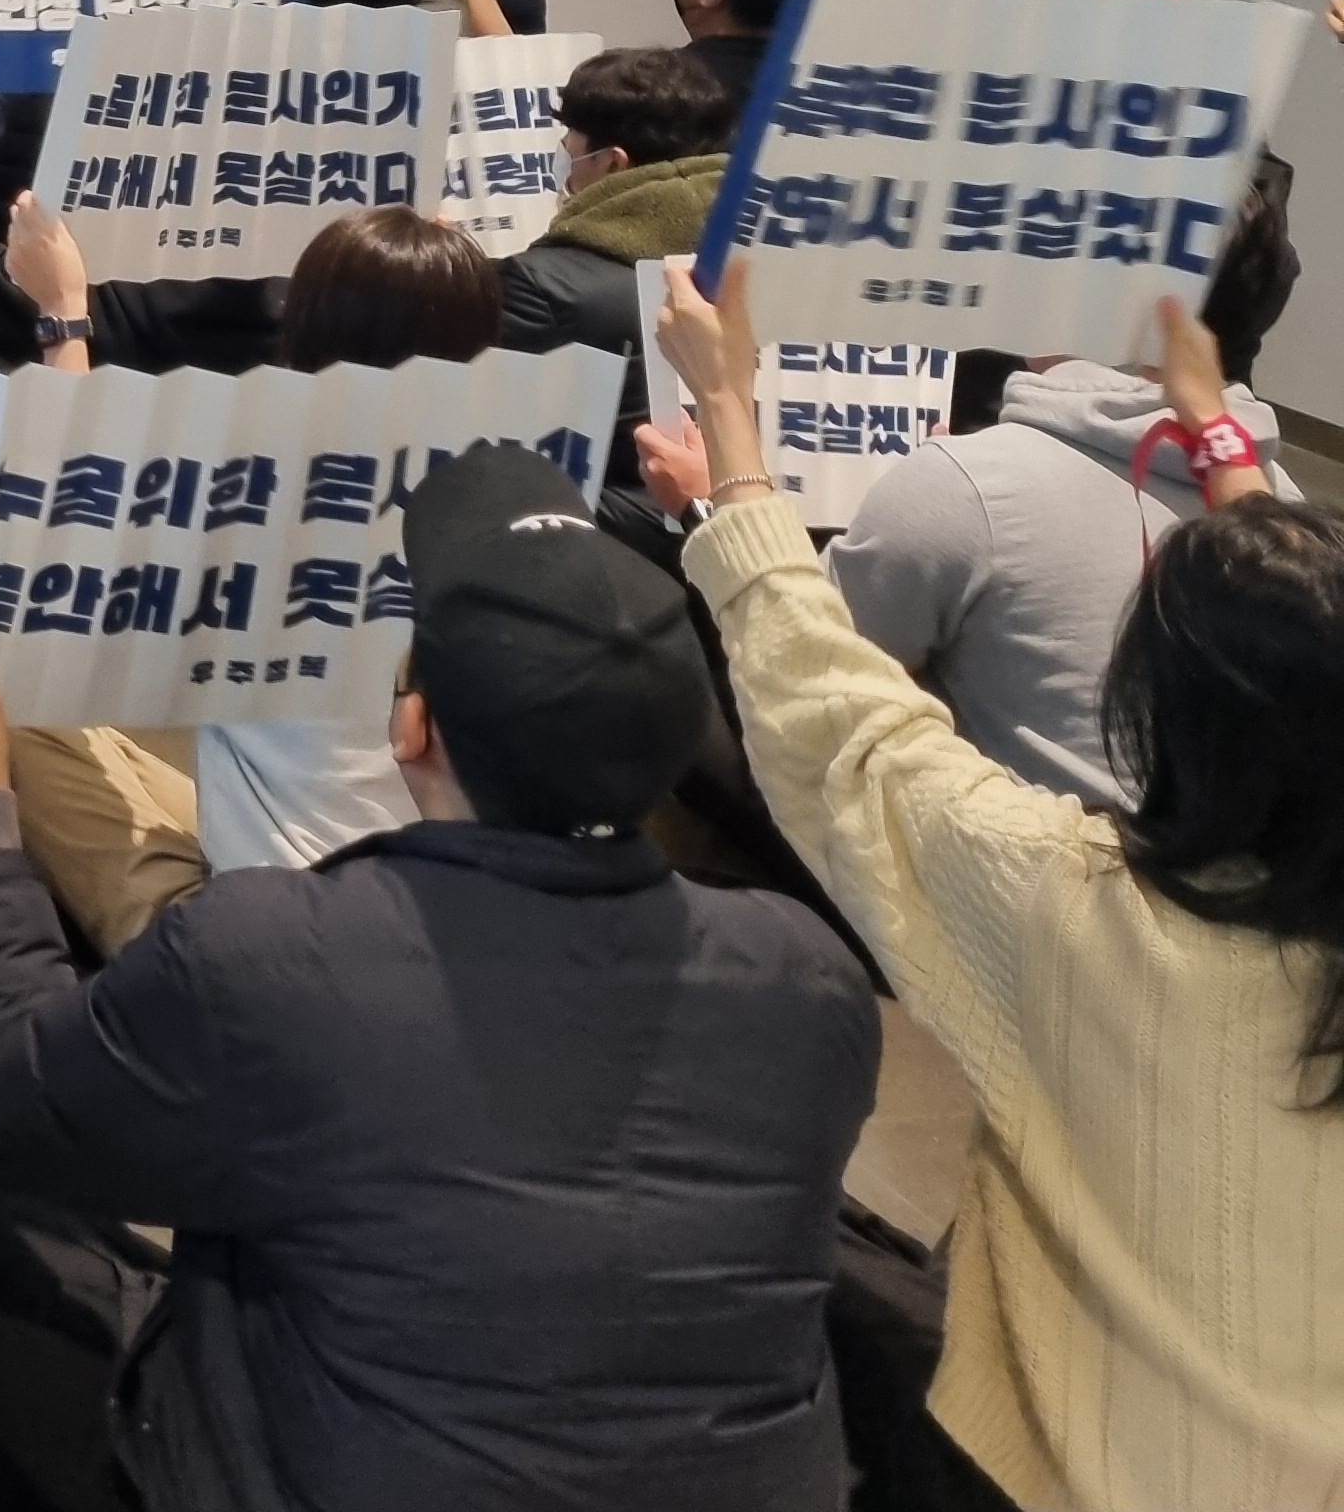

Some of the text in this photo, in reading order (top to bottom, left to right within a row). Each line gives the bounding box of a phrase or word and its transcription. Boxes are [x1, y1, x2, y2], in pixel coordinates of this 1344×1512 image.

[222, 70, 420, 128] 분사인가
[212, 150, 417, 207] 못살겠다
[283, 552, 415, 630] 못살
